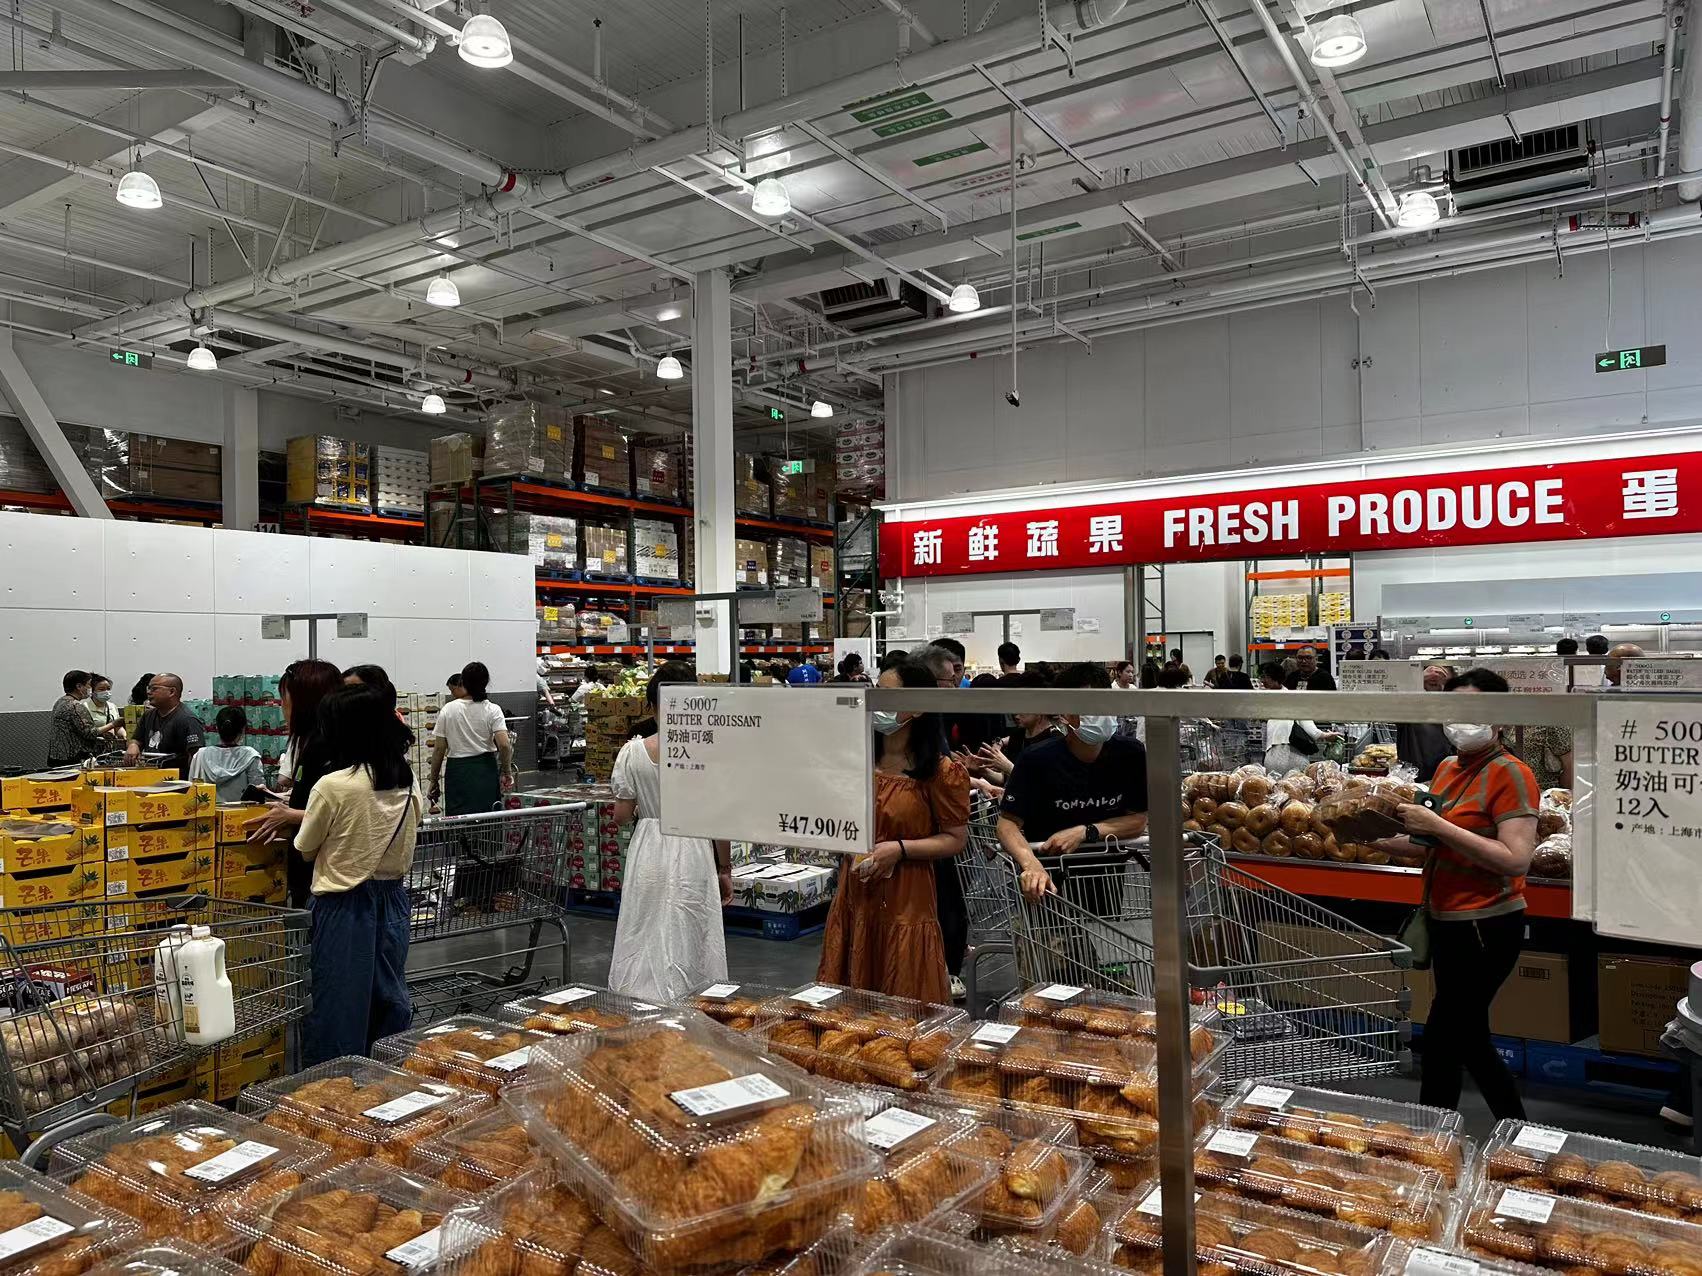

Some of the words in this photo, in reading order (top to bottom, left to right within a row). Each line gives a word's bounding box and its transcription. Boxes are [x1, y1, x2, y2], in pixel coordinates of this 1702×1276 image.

[1621, 468, 1679, 520] 蛋
[1163, 500, 1299, 548] FRESH
[1327, 478, 1565, 537] PRODUCE
[913, 515, 1124, 565] 新鲜蔬果
[669, 698, 677, 710] #
[683, 698, 718, 711] 50007
[666, 713, 702, 726] BUTTER
[707, 715, 762, 728] CROISSANT
[1620, 719, 1638, 740] #
[667, 729, 714, 744] 奶油可颂
[667, 746, 690, 760] 12入
[1613, 744, 1700, 766] BUTTER
[1614, 768, 1702, 795] 奶油可
[138, 801, 171, 820] 芒果
[1616, 797, 1670, 819] 12入
[778, 813, 860, 841] ¥47.90/份
[138, 834, 170, 854] 芒果
[16, 847, 52, 868] 芒果
[137, 868, 169, 887] 芒果
[17, 884, 54, 905] 芒果
